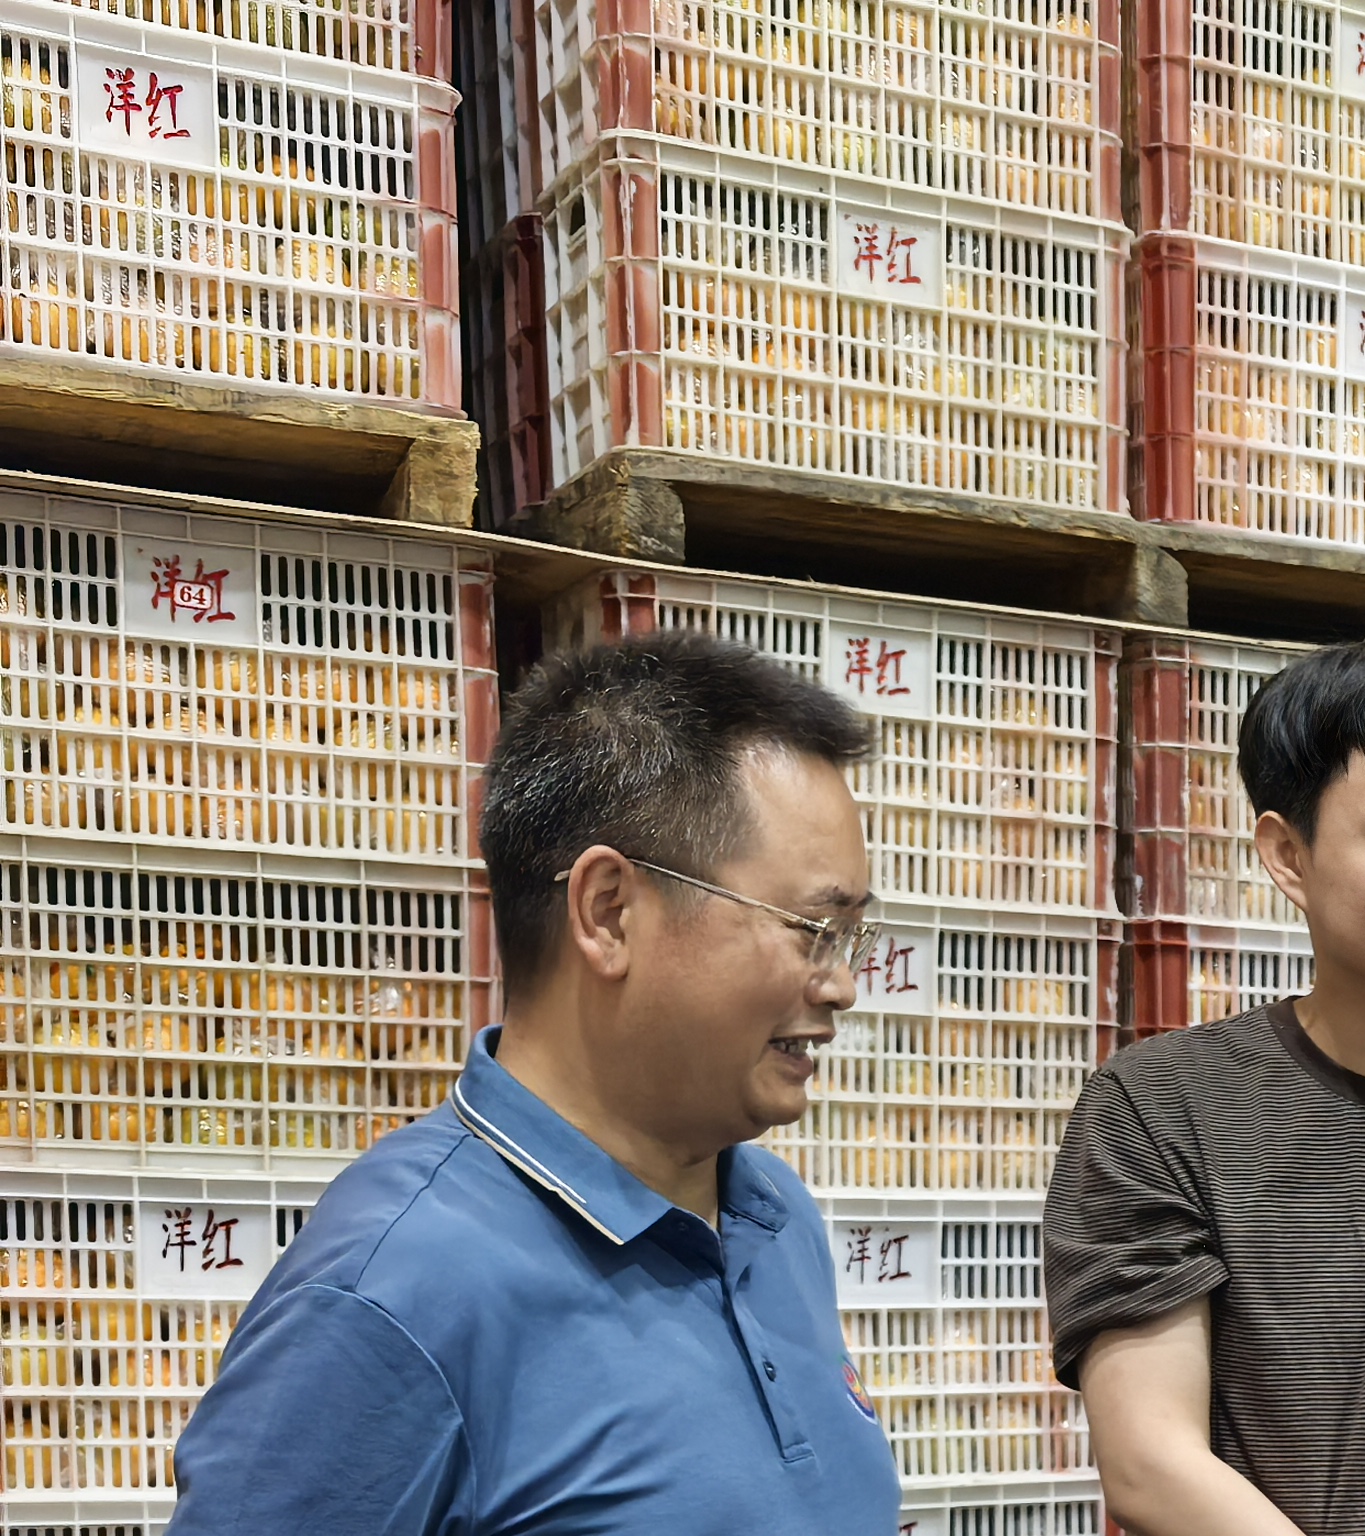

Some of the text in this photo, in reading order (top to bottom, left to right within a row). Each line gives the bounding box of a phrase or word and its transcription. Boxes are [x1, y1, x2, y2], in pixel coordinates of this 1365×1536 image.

[103, 67, 191, 140] 洋红
[854, 224, 922, 285] 洋红
[180, 585, 206, 606] 64
[845, 637, 911, 697] 洋红
[159, 1206, 243, 1272] 洋红
[845, 1225, 912, 1284] 洋红
